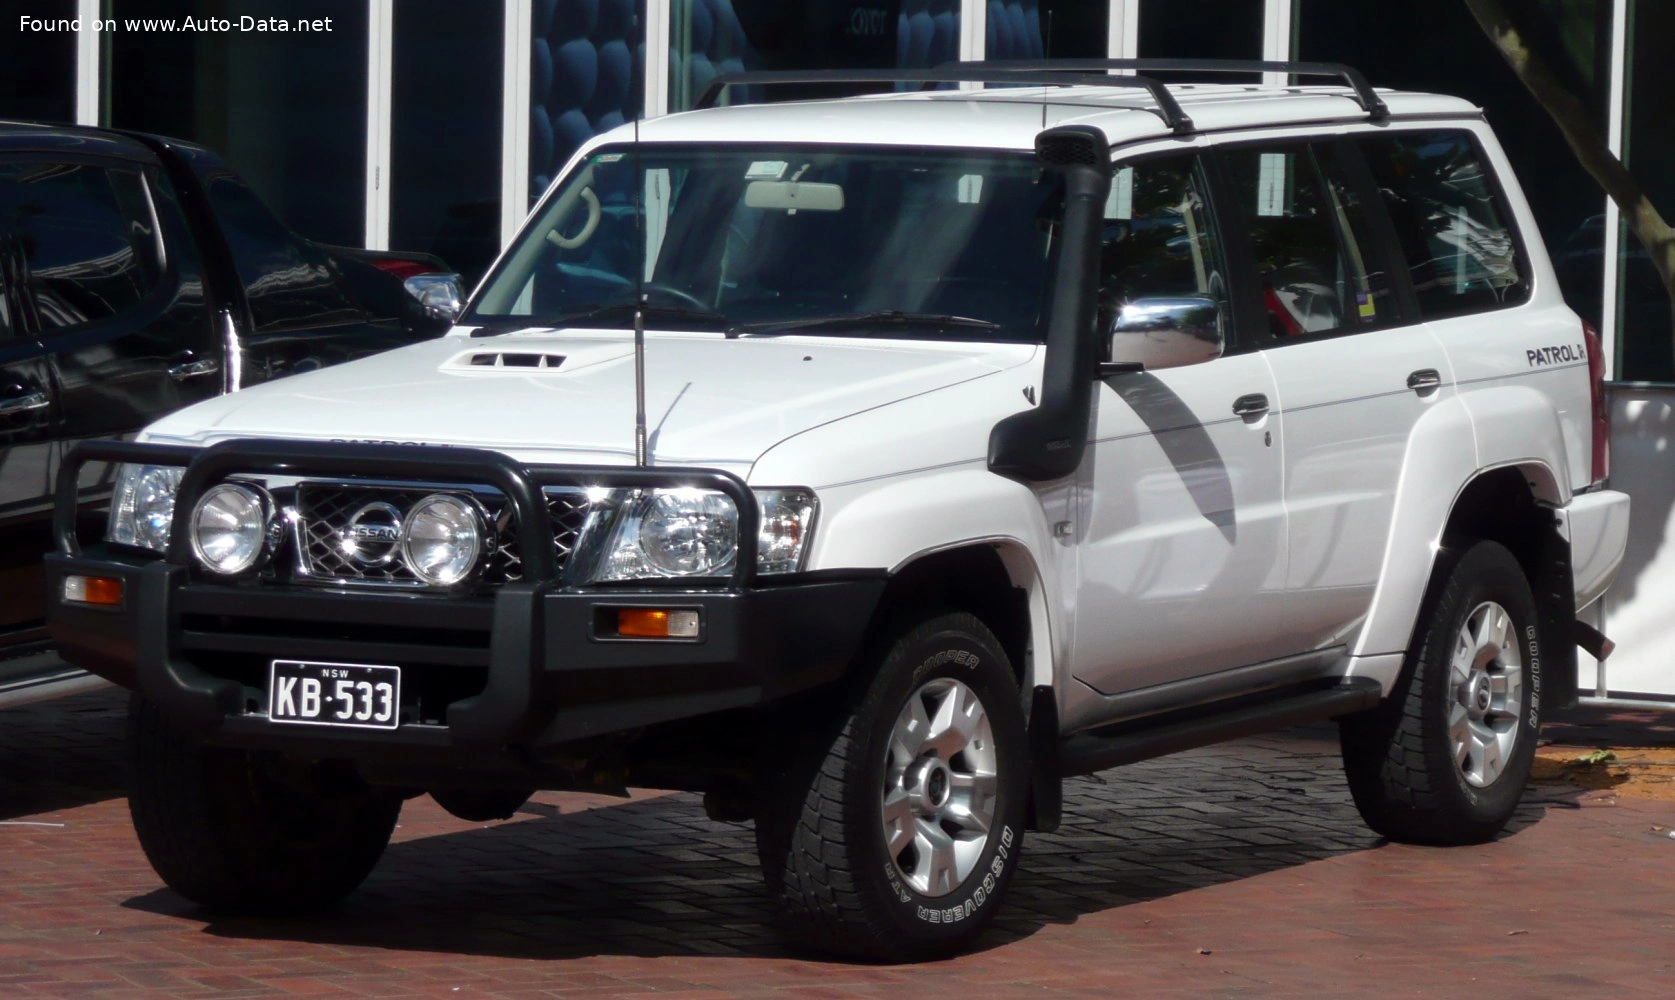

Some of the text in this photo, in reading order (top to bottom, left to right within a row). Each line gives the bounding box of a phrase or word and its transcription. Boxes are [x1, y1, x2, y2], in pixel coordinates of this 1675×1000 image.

[1526, 344, 1579, 367] PATROL
[322, 668, 349, 679] NSW
[917, 825, 1014, 924] DISCOVERER
